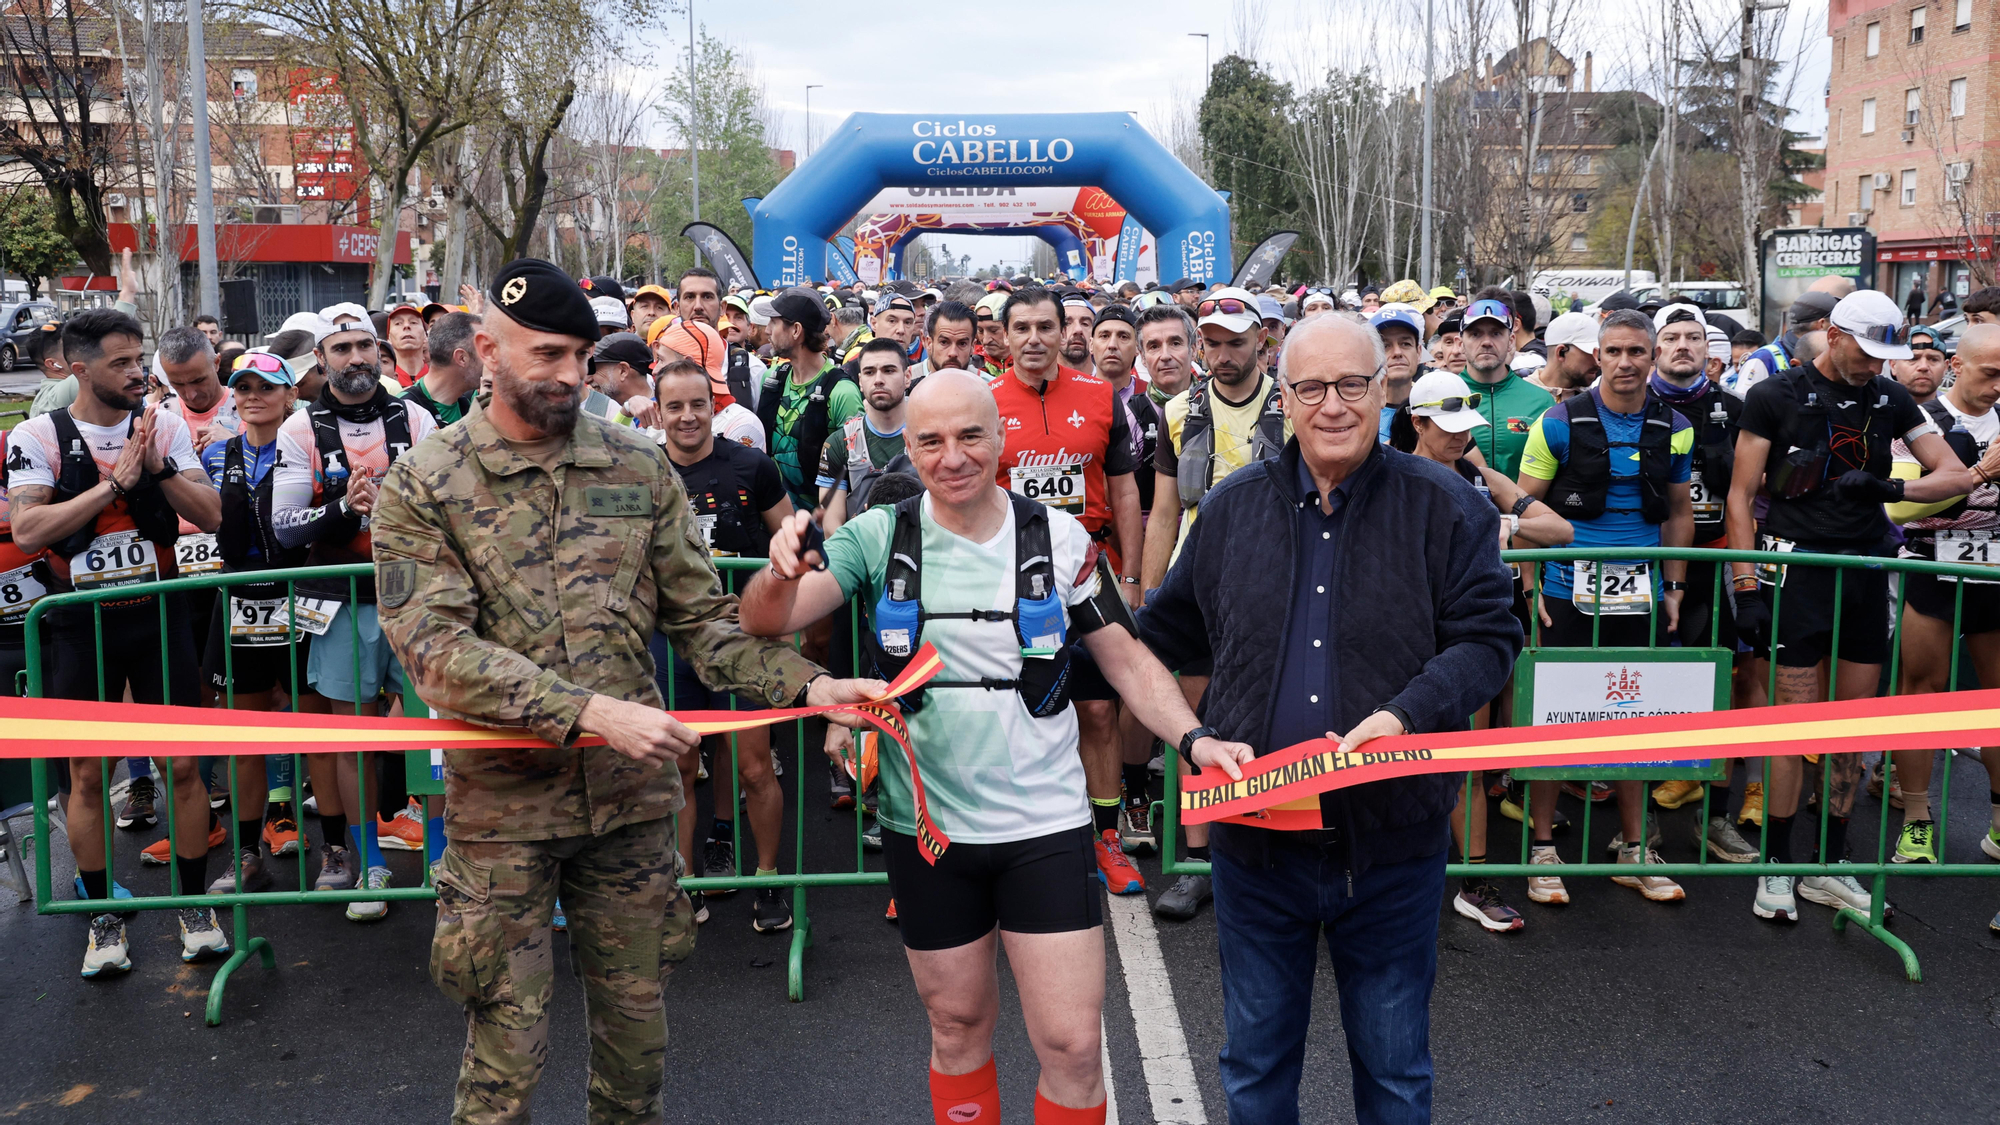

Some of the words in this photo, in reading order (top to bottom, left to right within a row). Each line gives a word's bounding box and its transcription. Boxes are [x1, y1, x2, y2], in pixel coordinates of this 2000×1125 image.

[912, 120, 997, 138] Ciclos
[912, 138, 1074, 165] CABELLO
[927, 165, 1053, 176] CiclosCABELLO.COM
[1118, 226, 1131, 280] CABELLO
[1776, 234, 1862, 253] BARRIGAS
[1203, 231, 1216, 279] Ciclos
[1776, 250, 1862, 267] CERVECERAS
[1546, 277, 1626, 287] CONWAY
[1780, 269, 1791, 277] LA
[1072, 374, 1103, 385] Jimbee
[1016, 446, 1094, 469] Jimbee
[1023, 476, 1074, 499] 640
[615, 504, 642, 513] JANSA
[86, 543, 145, 571] 610
[1958, 542, 1989, 561] 21
[117, 578, 140, 586] RUNING
[1586, 574, 1638, 596] 524
[1546, 711, 1627, 724] AYUNTAMIENTO
[1186, 781, 1242, 810] TRAIL
[1246, 753, 1326, 797] GUZMÁN
[1332, 751, 1356, 772] EL
[1362, 748, 1433, 764] BUENO
